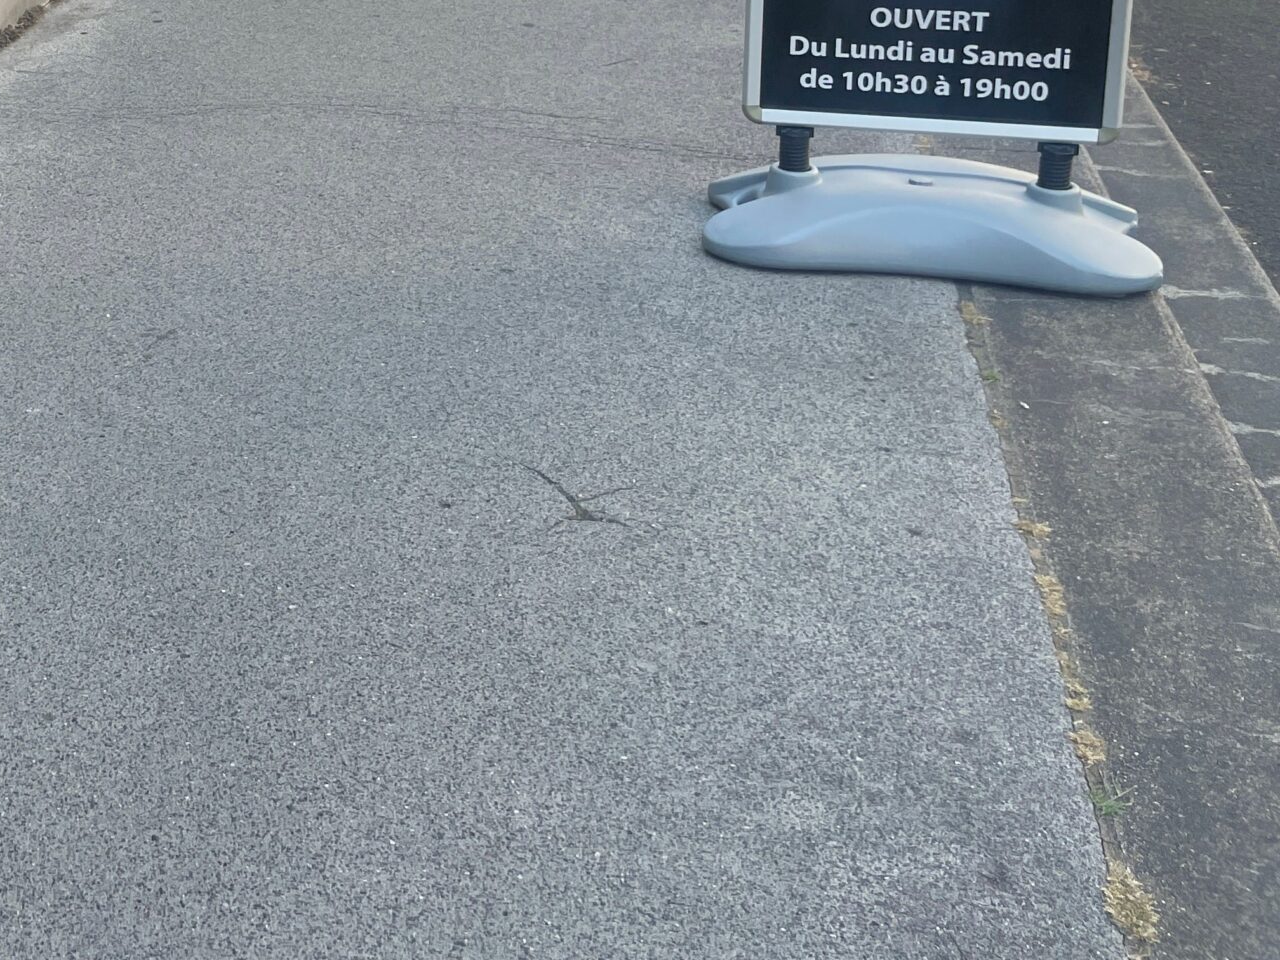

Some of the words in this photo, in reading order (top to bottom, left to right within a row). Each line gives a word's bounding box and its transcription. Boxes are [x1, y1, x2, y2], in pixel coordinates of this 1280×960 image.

[870, 7, 990, 32] OUVERT
[789, 35, 827, 57] Du
[834, 37, 913, 62] Lundi
[919, 46, 955, 64] au
[962, 44, 1071, 70] Samedi
[799, 67, 834, 90] de
[842, 71, 928, 95] 10h30
[933, 75, 951, 96] à
[959, 77, 1049, 102] 19h00
